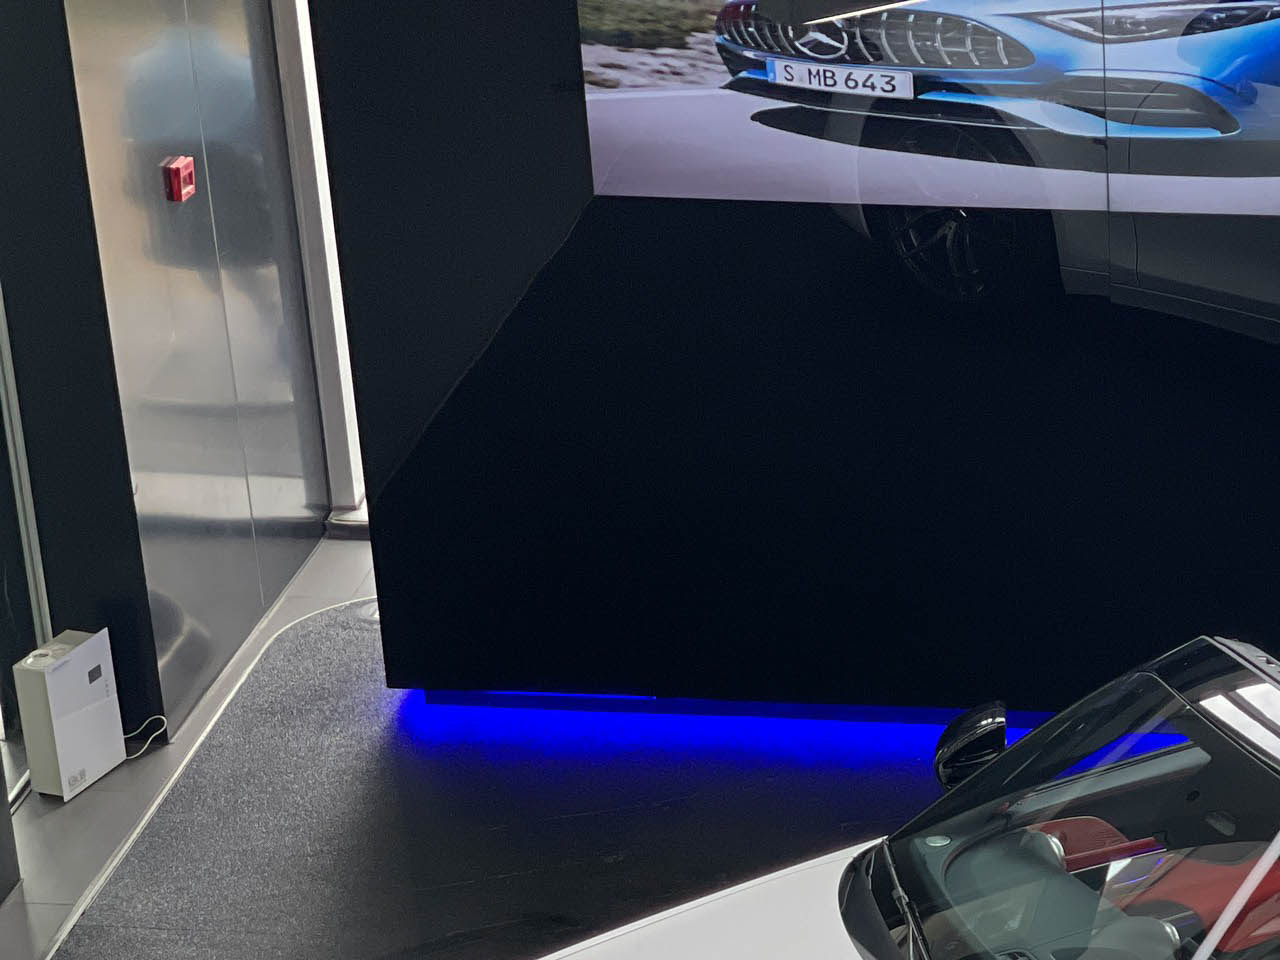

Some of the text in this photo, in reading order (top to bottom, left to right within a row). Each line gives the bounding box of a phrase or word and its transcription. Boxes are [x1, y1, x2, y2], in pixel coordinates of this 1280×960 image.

[783, 64, 897, 93] S MB 643
